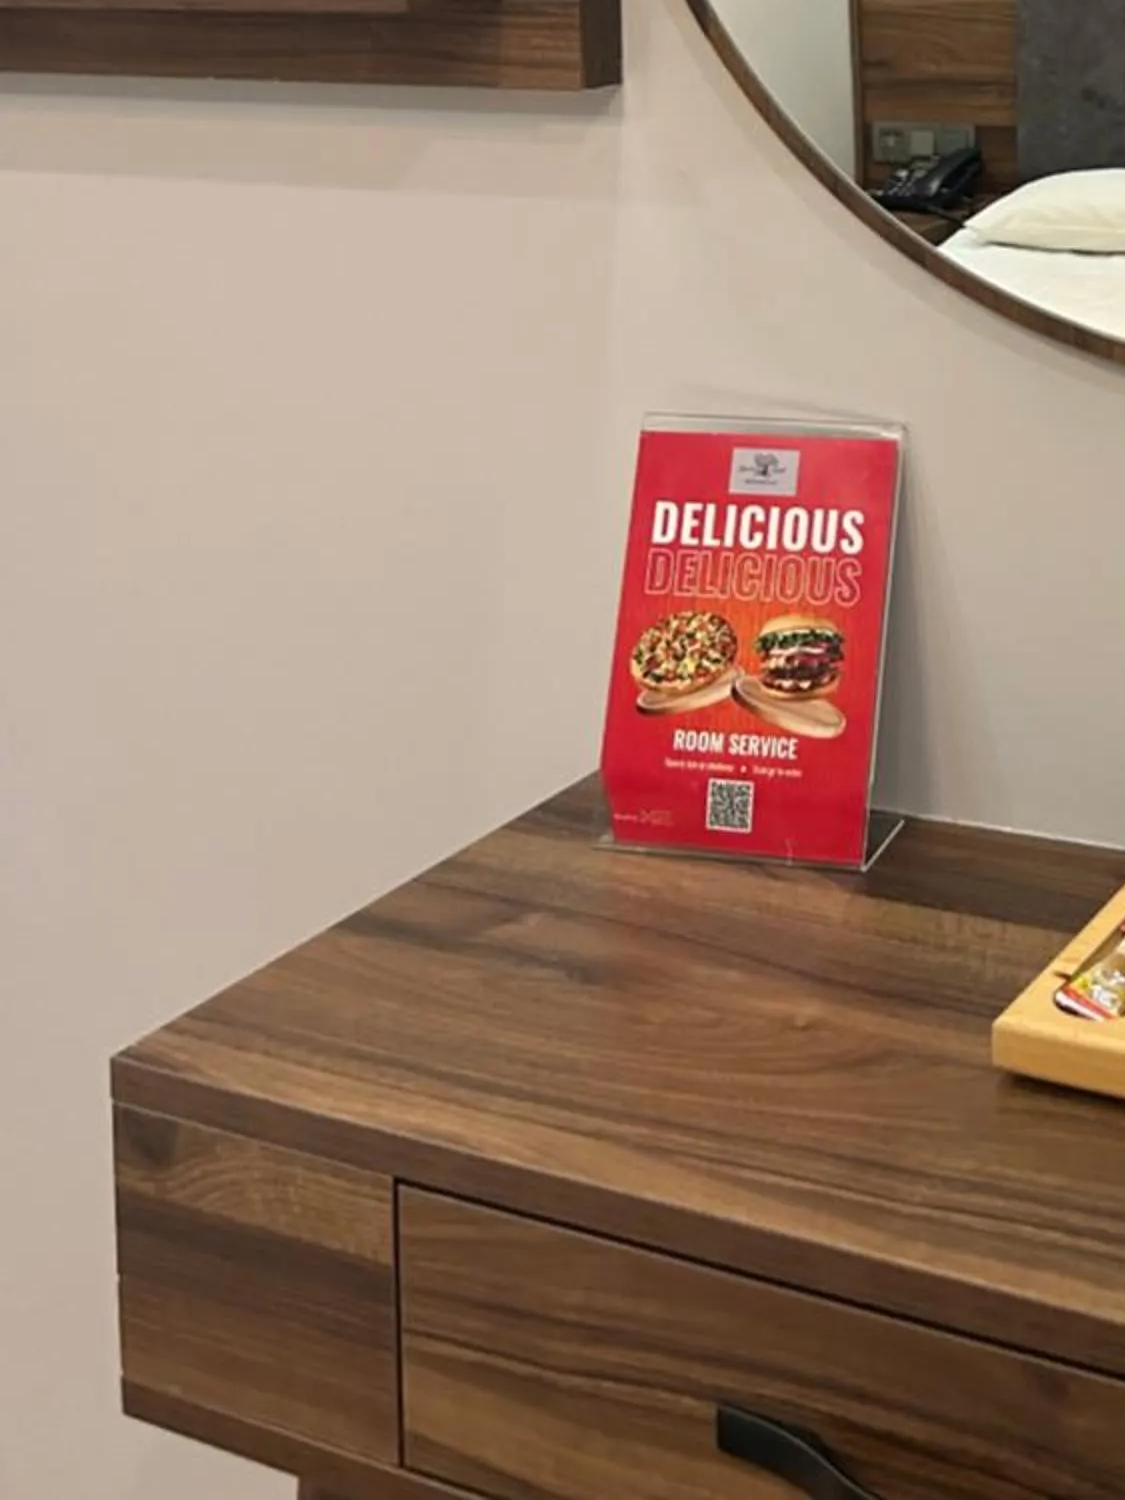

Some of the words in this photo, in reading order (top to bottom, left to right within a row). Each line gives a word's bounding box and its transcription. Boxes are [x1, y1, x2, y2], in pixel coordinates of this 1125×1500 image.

[652, 501, 865, 555] DELICIOUS
[644, 547, 863, 608] DELICIOUS
[673, 729, 725, 753] ROOM
[728, 732, 799, 760] SERVICE
